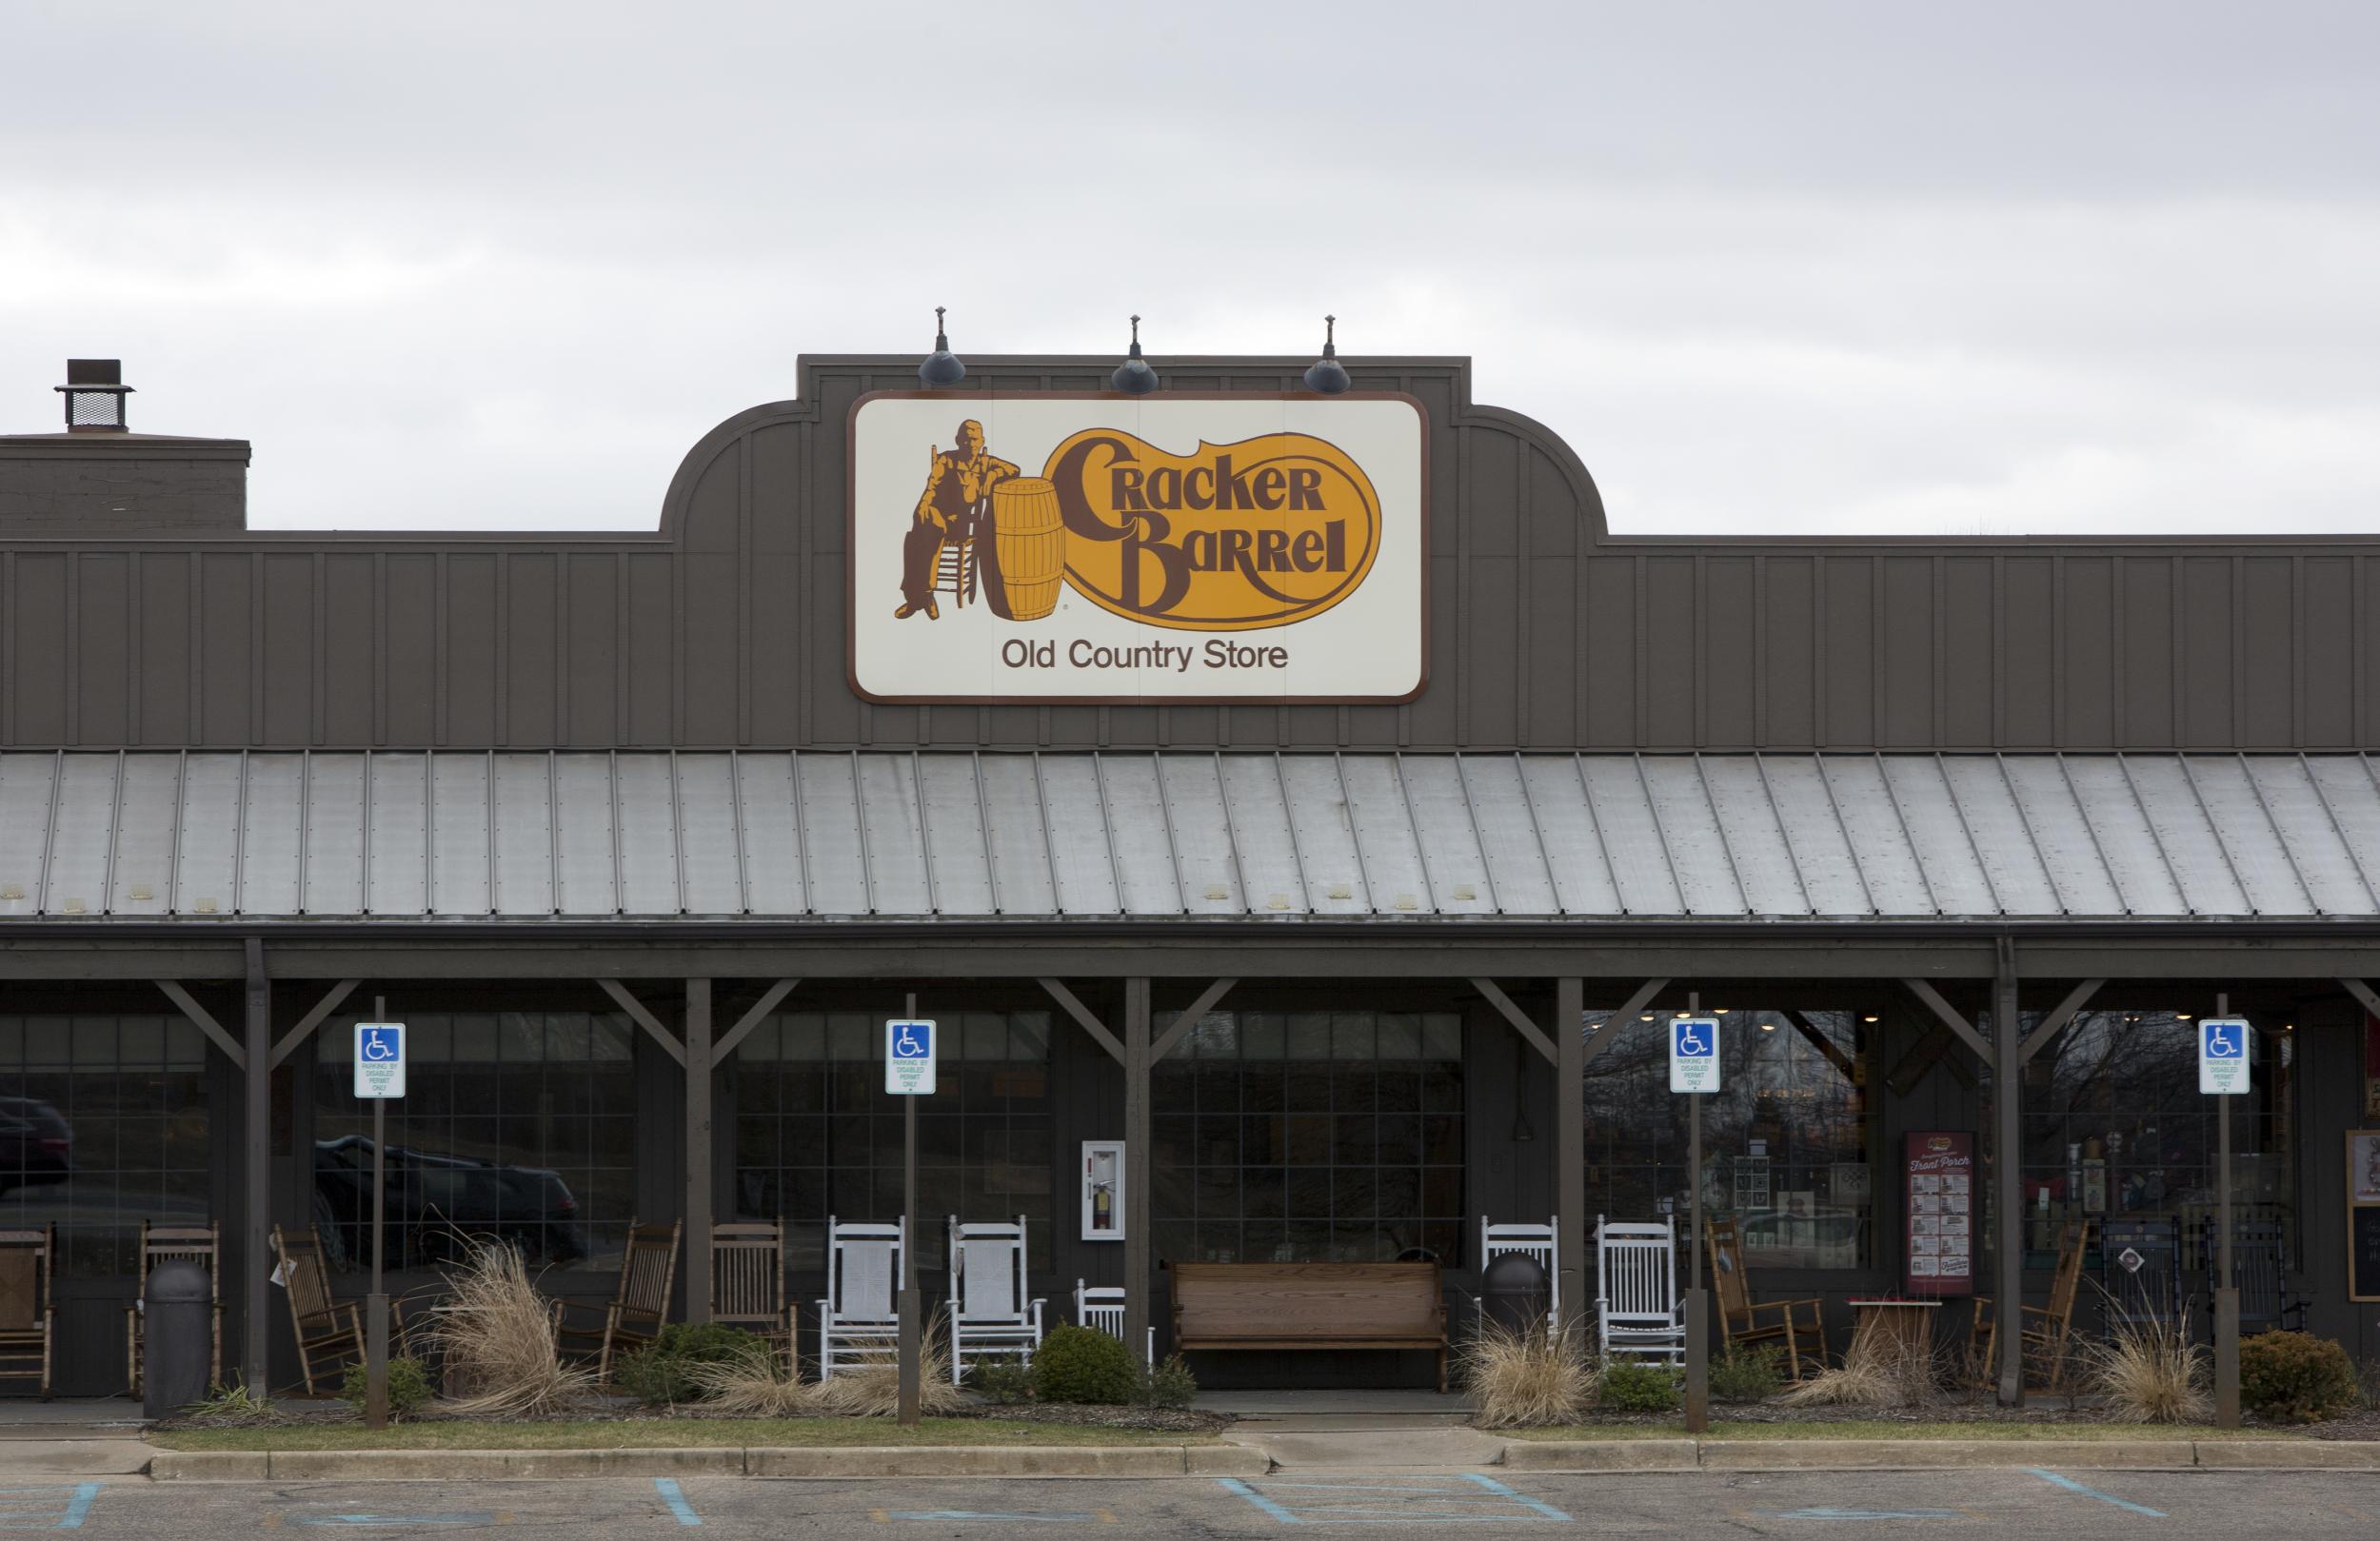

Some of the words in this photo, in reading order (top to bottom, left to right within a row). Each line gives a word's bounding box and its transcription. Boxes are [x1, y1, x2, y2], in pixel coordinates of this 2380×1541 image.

[1002, 639, 1056, 668] Old
[1068, 639, 1194, 673] Country
[1203, 639, 1288, 668] Store
[1910, 1159, 1938, 1172] Front
[1940, 1156, 1971, 1168] Porch
